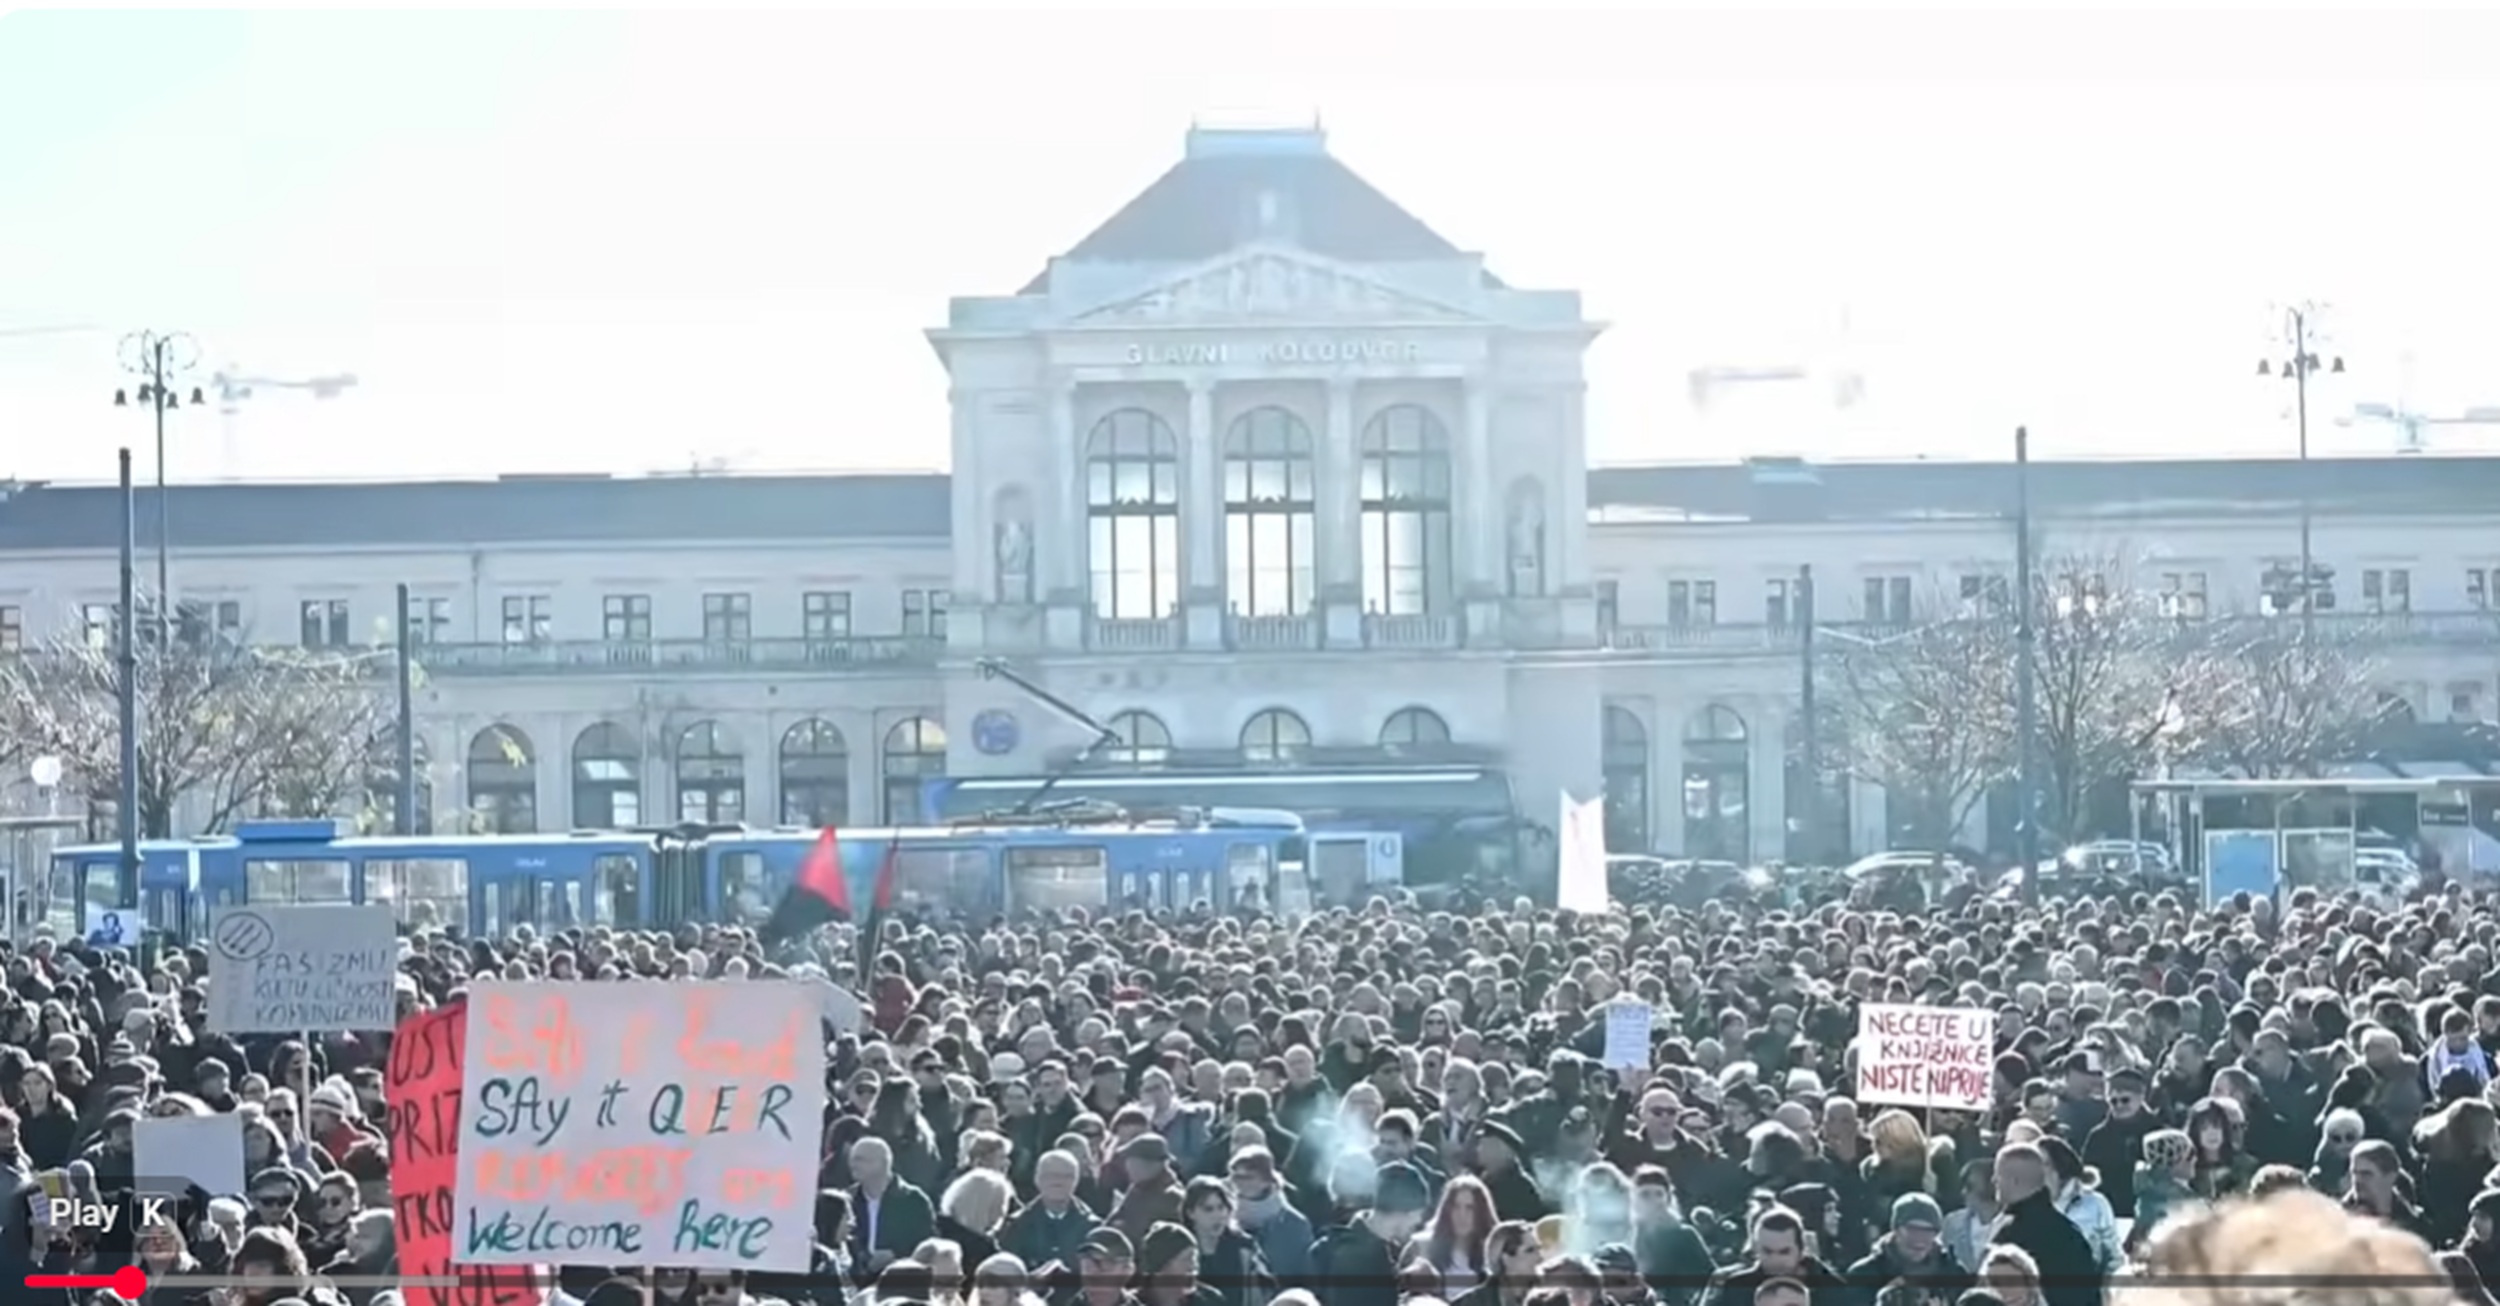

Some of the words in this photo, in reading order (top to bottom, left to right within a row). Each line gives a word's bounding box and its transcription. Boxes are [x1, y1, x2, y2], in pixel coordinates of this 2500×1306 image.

[1125, 343, 1227, 364] GLAVNI
[1969, 1017, 1986, 1041] U
[1861, 1064, 1923, 1093] NISTE
[596, 1079, 629, 1128] it
[468, 1205, 643, 1255] Welcome
[673, 1198, 773, 1259] here
